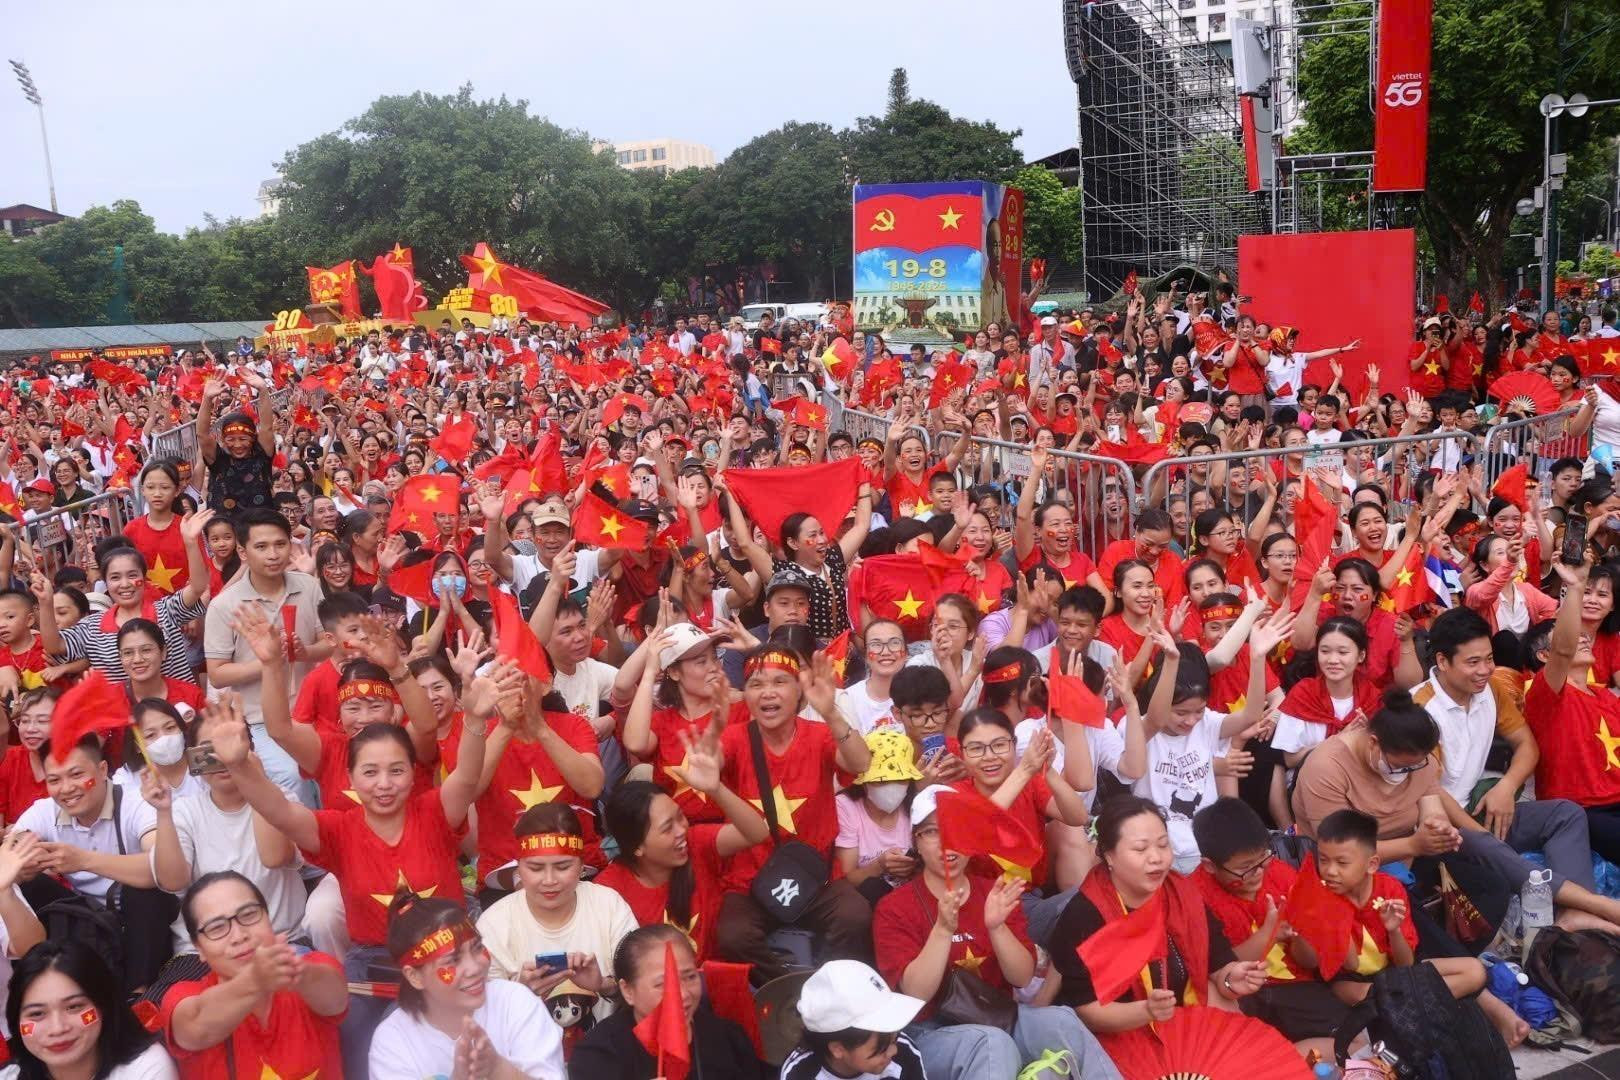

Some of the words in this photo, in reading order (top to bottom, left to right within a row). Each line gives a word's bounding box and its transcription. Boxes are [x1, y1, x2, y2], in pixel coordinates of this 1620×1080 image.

[1391, 72, 1423, 81] viettel
[1384, 81, 1423, 107] 5G
[884, 259, 947, 279] 19-8
[489, 293, 518, 317] 80
[274, 308, 302, 331] 80
[527, 834, 540, 850] TÔI
[540, 833, 556, 849] YÊU
[770, 878, 801, 907] NY
[420, 938, 438, 956] TÔI
[433, 927, 455, 947] YÊU
